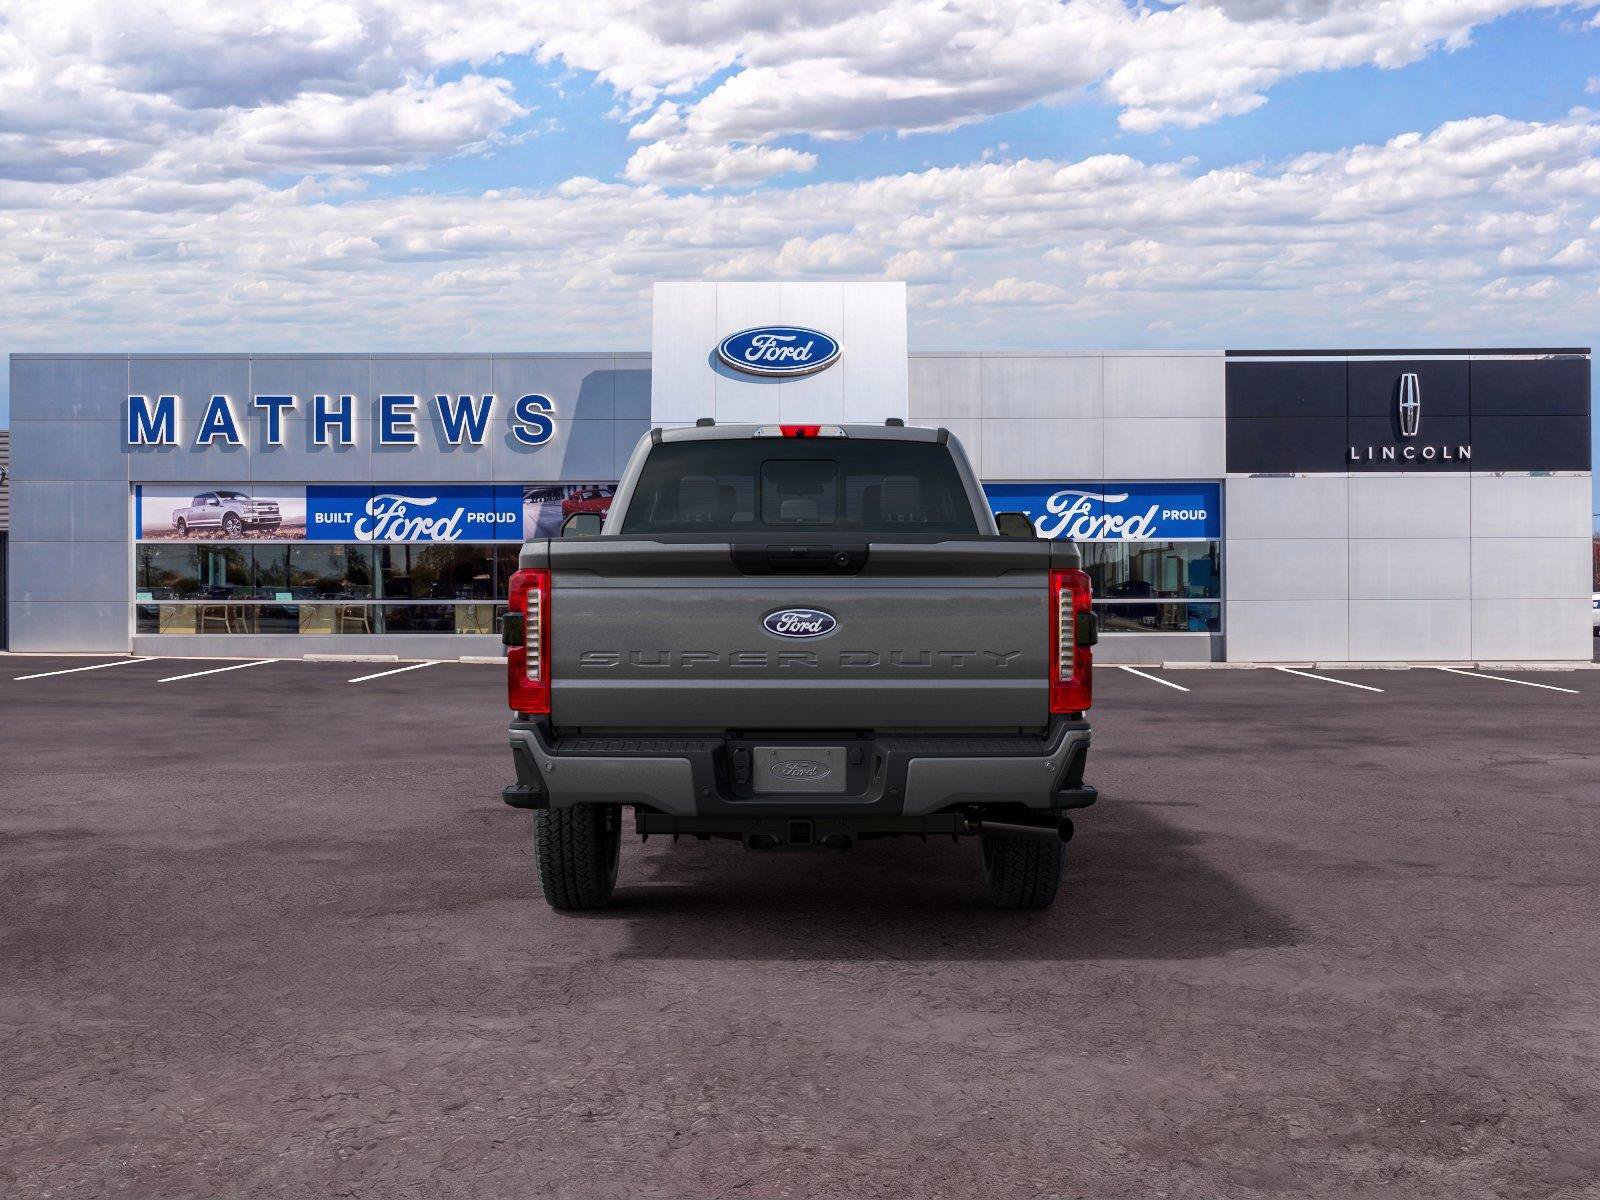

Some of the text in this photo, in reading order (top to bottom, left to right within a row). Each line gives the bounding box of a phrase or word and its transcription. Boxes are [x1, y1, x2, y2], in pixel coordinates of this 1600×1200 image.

[744, 333, 814, 362] Ford
[127, 394, 557, 446] MATHEWS
[1350, 445, 1472, 460] LINCOLN
[315, 494, 516, 541] BUILT Ford PROUD
[1034, 490, 1208, 540] Ford PROUD
[776, 612, 824, 633] Ford
[580, 650, 1023, 668] SUPER DUTY
[782, 762, 818, 777] Ford
